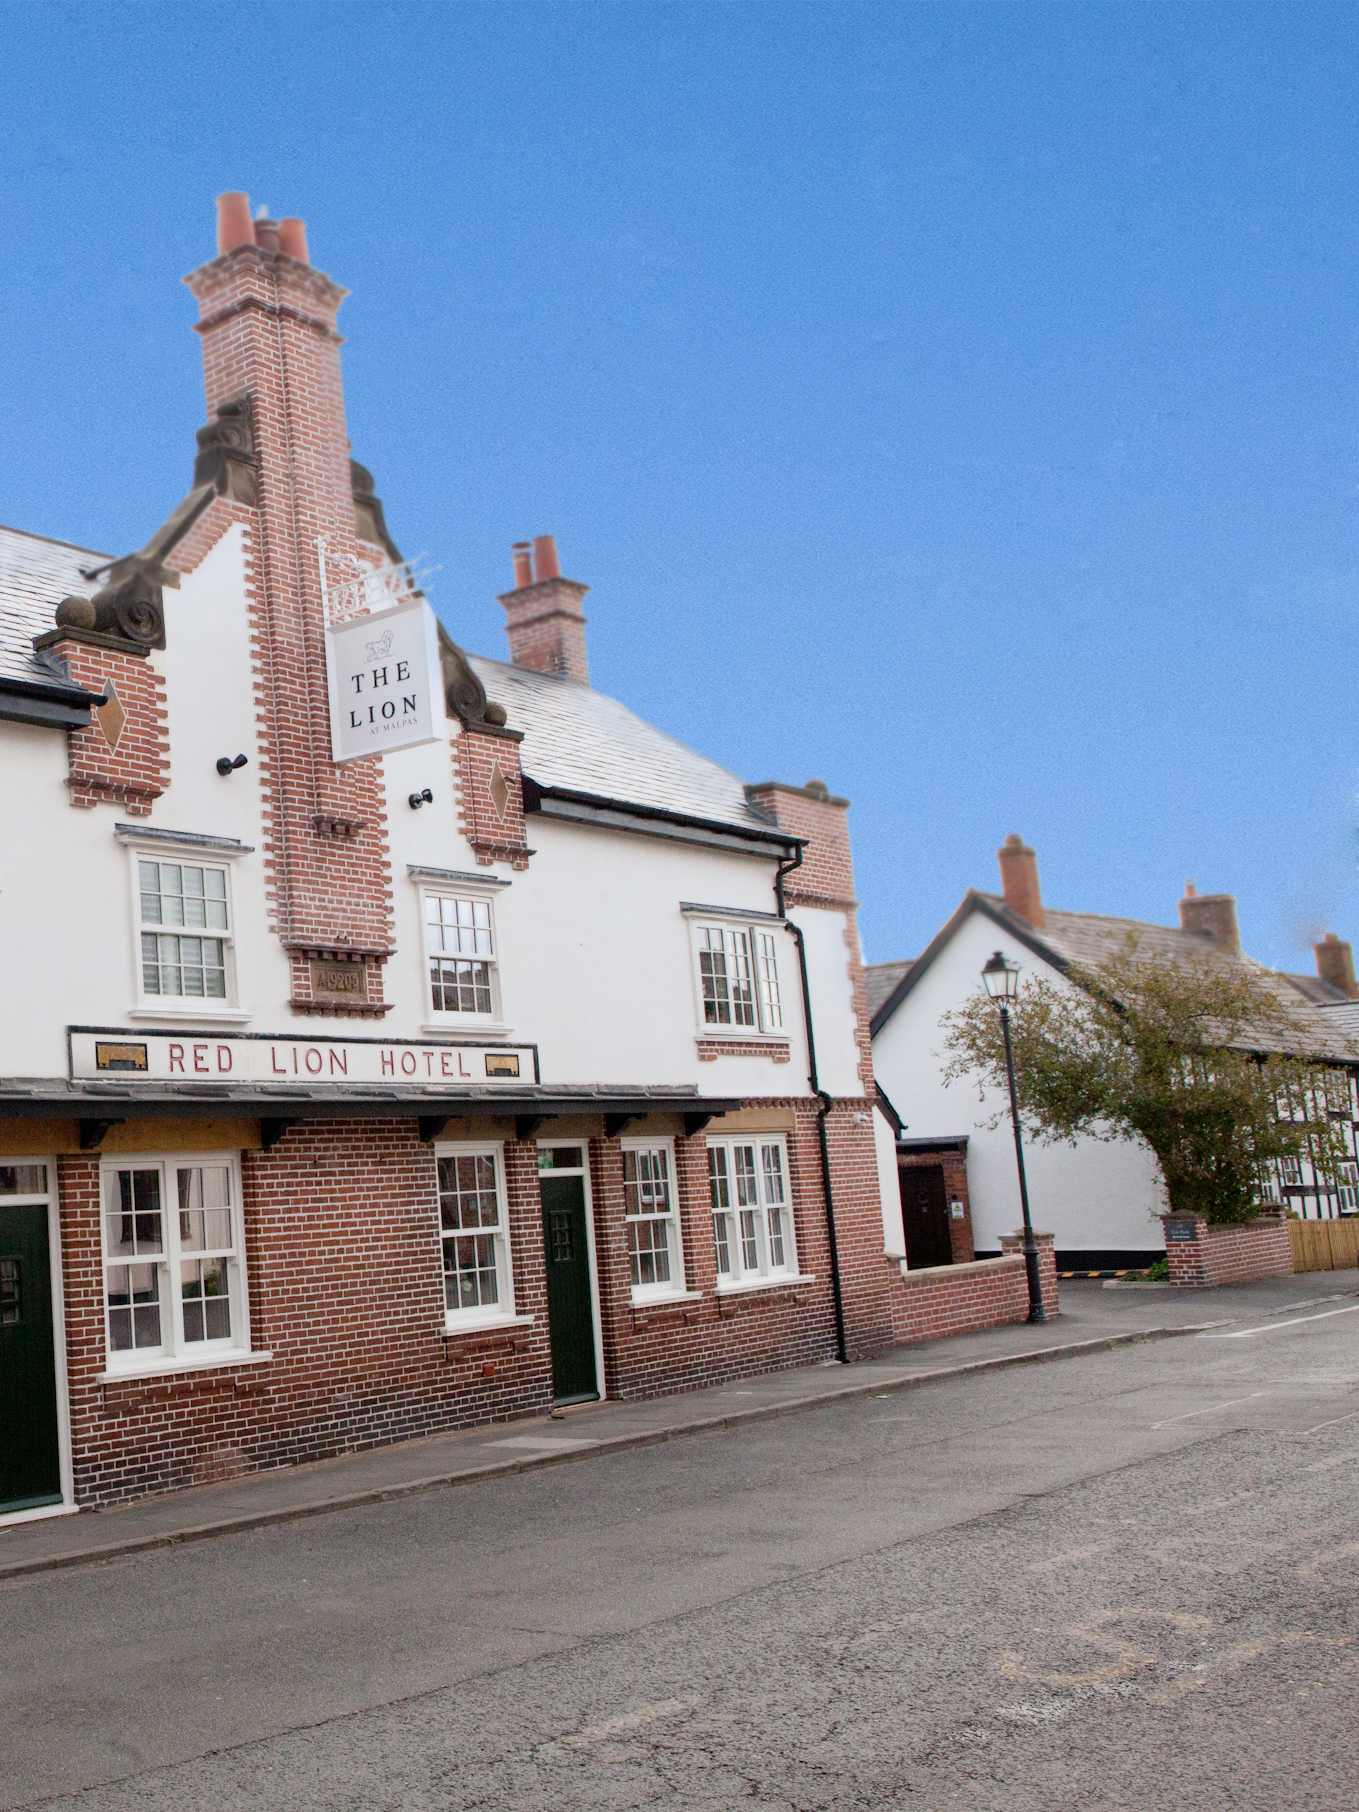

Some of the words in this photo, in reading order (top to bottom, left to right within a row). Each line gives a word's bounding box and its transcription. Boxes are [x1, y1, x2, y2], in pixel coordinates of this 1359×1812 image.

[351, 661, 411, 694] THE
[349, 694, 417, 728] LION
[370, 727, 380, 735] AT
[383, 717, 418, 732] MALPAS
[169, 1043, 233, 1073] RED
[271, 1046, 348, 1075] LION
[381, 1050, 471, 1078] HOTEL
